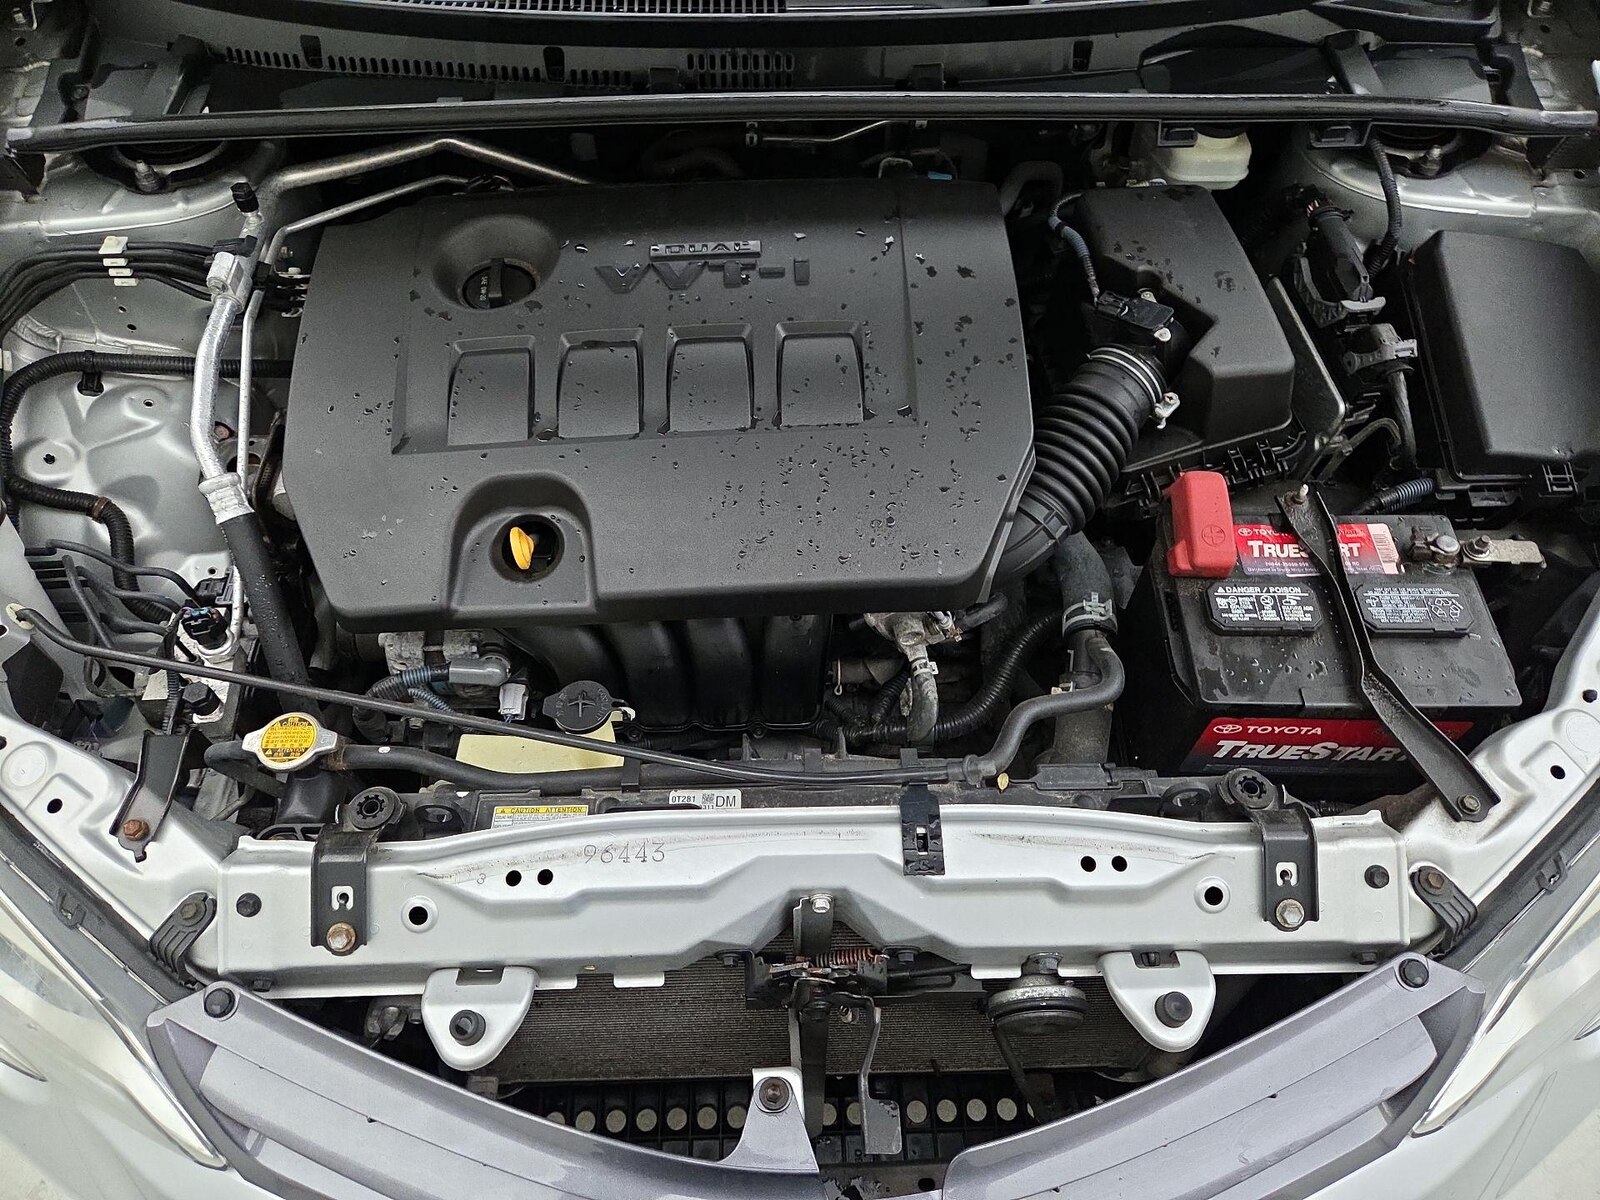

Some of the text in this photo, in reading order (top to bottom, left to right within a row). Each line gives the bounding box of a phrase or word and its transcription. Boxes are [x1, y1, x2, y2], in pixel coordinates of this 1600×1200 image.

[1268, 586, 1302, 594] POISON
[1246, 725, 1322, 735] TOYOTA
[715, 795, 737, 808] DM
[583, 841, 665, 864] 96443
